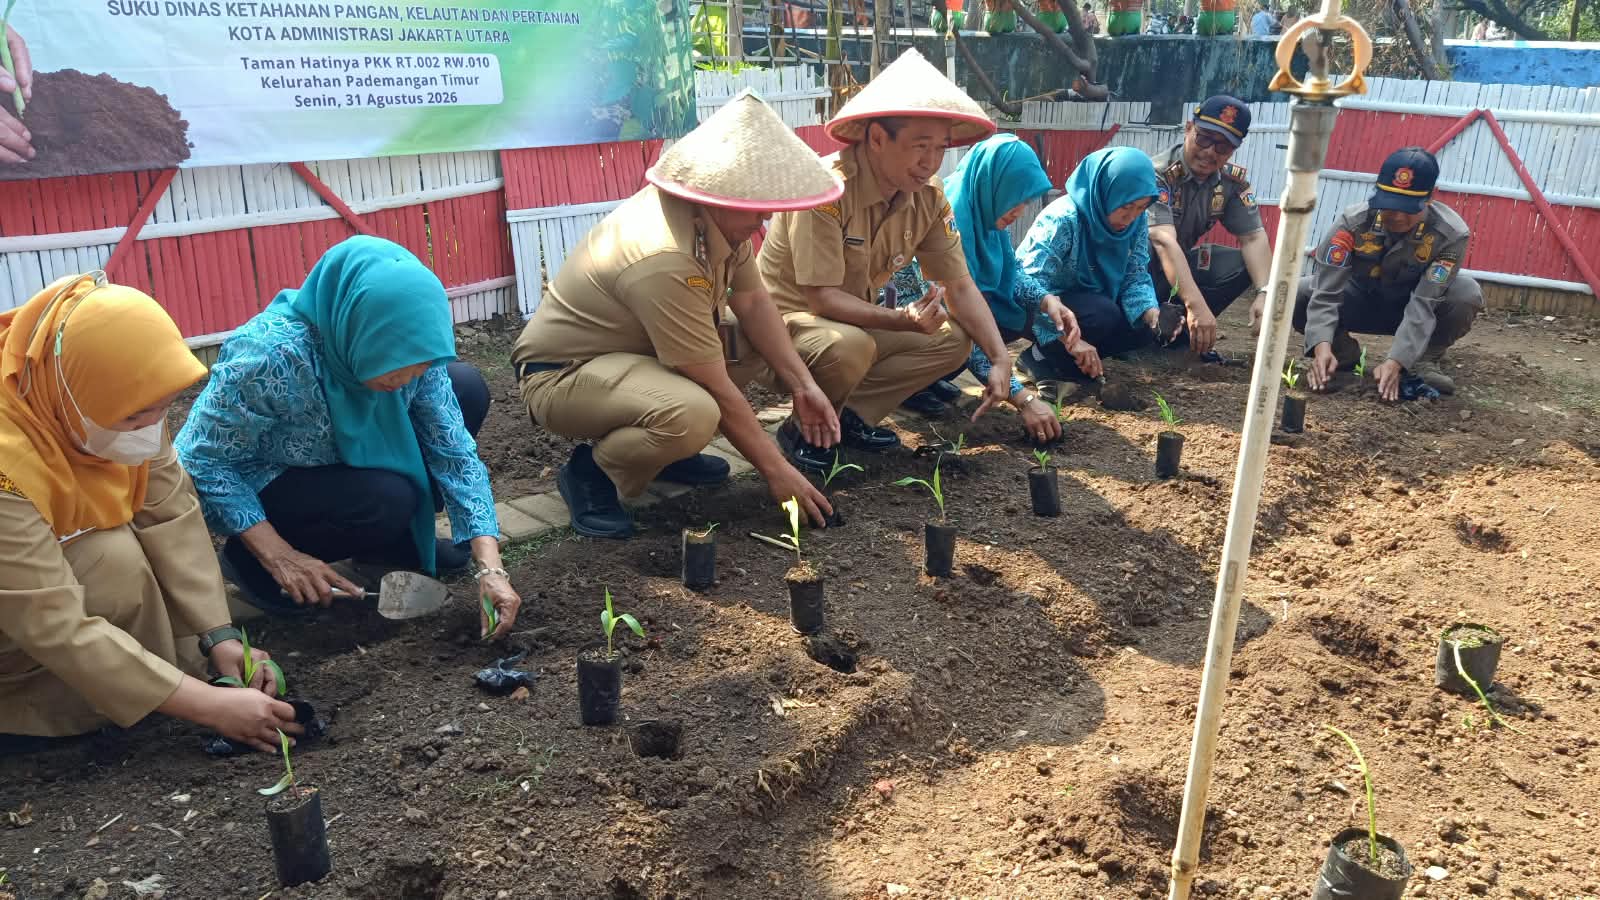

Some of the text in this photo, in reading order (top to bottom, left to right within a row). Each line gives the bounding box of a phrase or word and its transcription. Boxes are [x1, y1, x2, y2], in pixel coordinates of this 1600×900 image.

[108, 0, 580, 24] SUKU DINAS KETAHANAN PANGAN, KELAUTAN DAN PERTANIAN
[228, 26, 511, 43] KOTA ADMINISTRASI JAKARTA UTARA
[240, 56, 490, 72] Taman Hatinya PKK RT.002 RW.010
[261, 74, 480, 89] Kelurahan Pademangan Timur
[295, 92, 458, 108] Senin, 31 Agustus 2026
